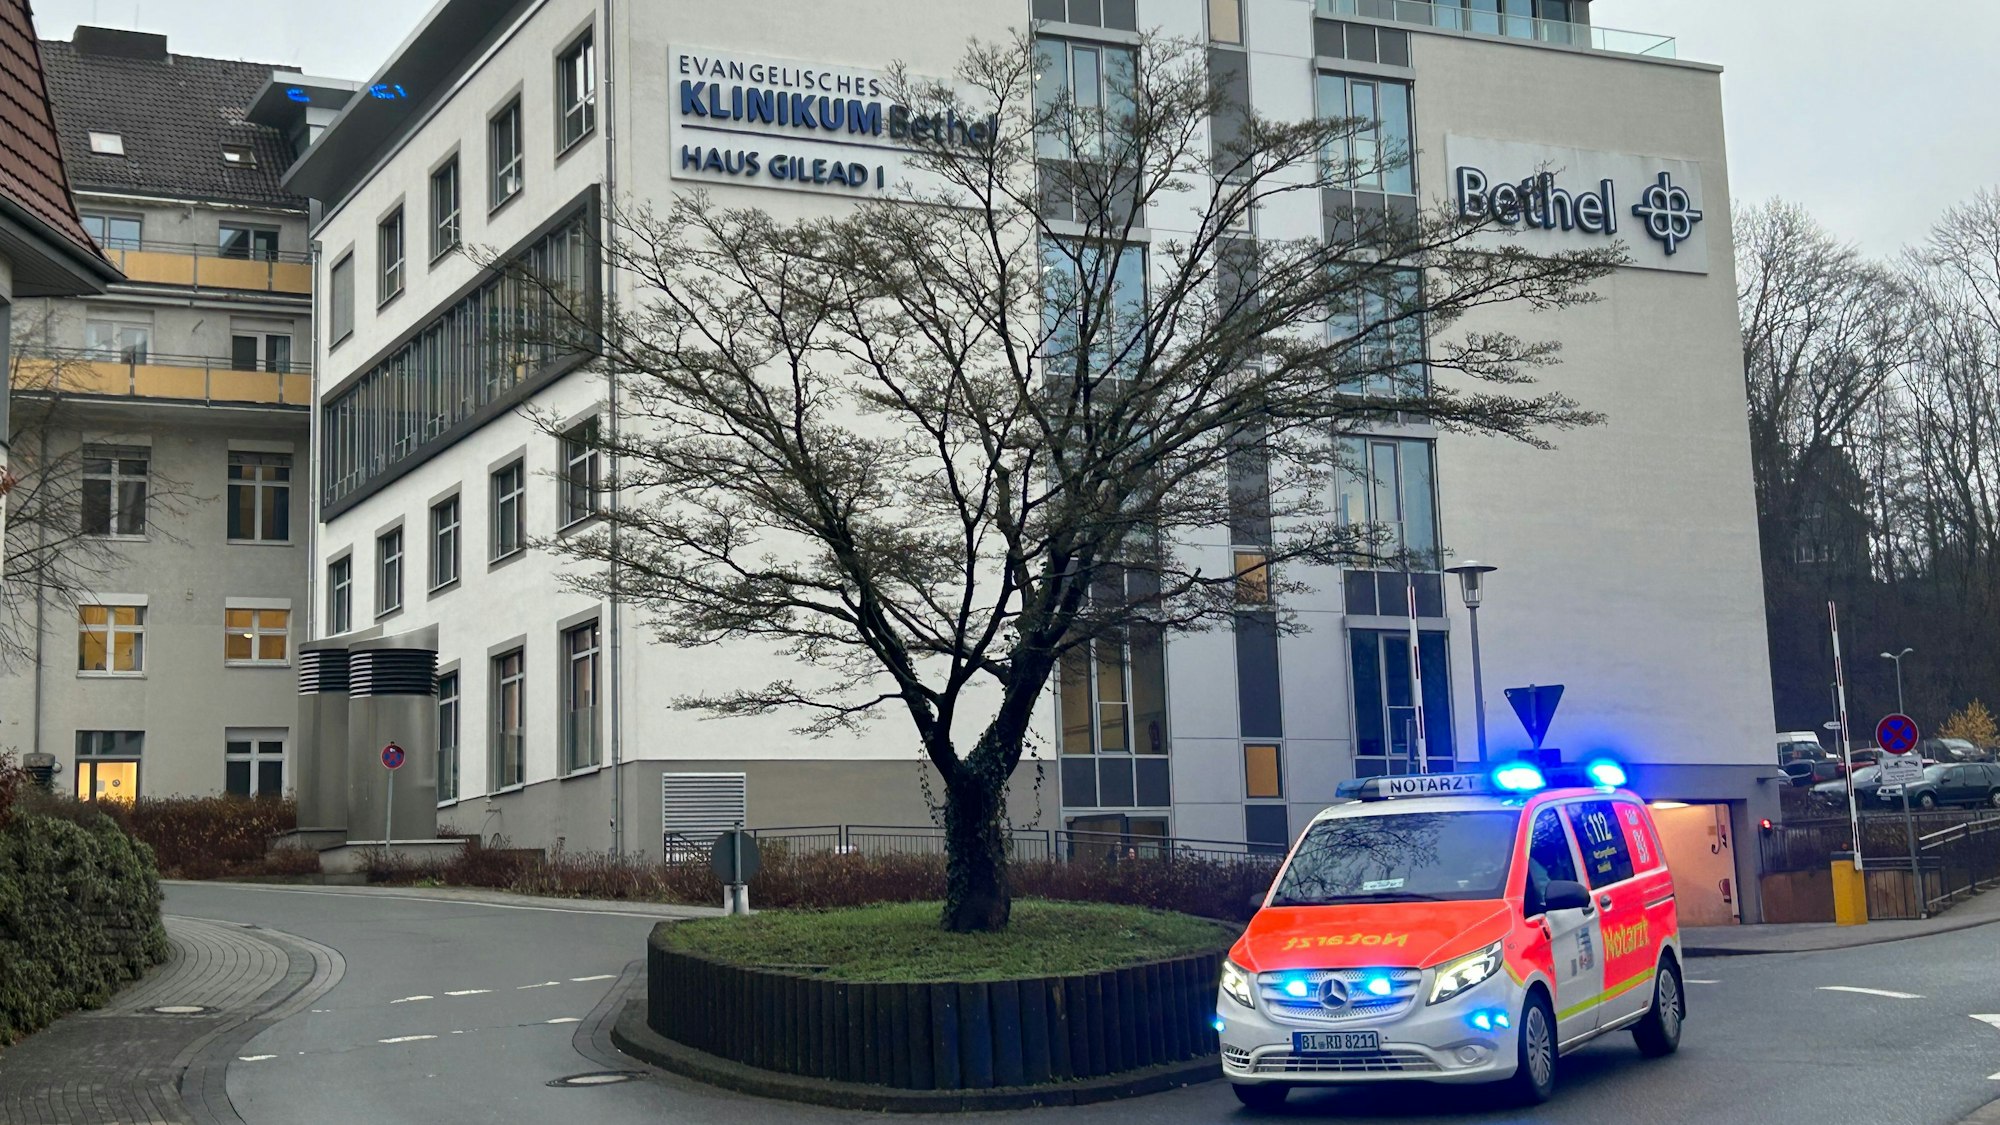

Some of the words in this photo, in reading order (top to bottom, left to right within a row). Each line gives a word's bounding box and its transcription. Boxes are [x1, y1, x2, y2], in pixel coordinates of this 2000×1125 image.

[679, 54, 881, 97] EVANGELISCHES
[681, 80, 882, 137] KLINIKUM
[888, 104, 997, 149] Bethel
[681, 144, 761, 177] HAUS
[768, 154, 869, 187] GILEAD
[876, 165, 885, 189] I
[1456, 166, 1617, 235] Bethel
[1390, 776, 1475, 793] NOTARZT
[1588, 811, 1613, 843] 112
[1302, 1035, 1317, 1050] BI
[1326, 1035, 1342, 1049] RD
[1345, 1034, 1377, 1050] 8211
